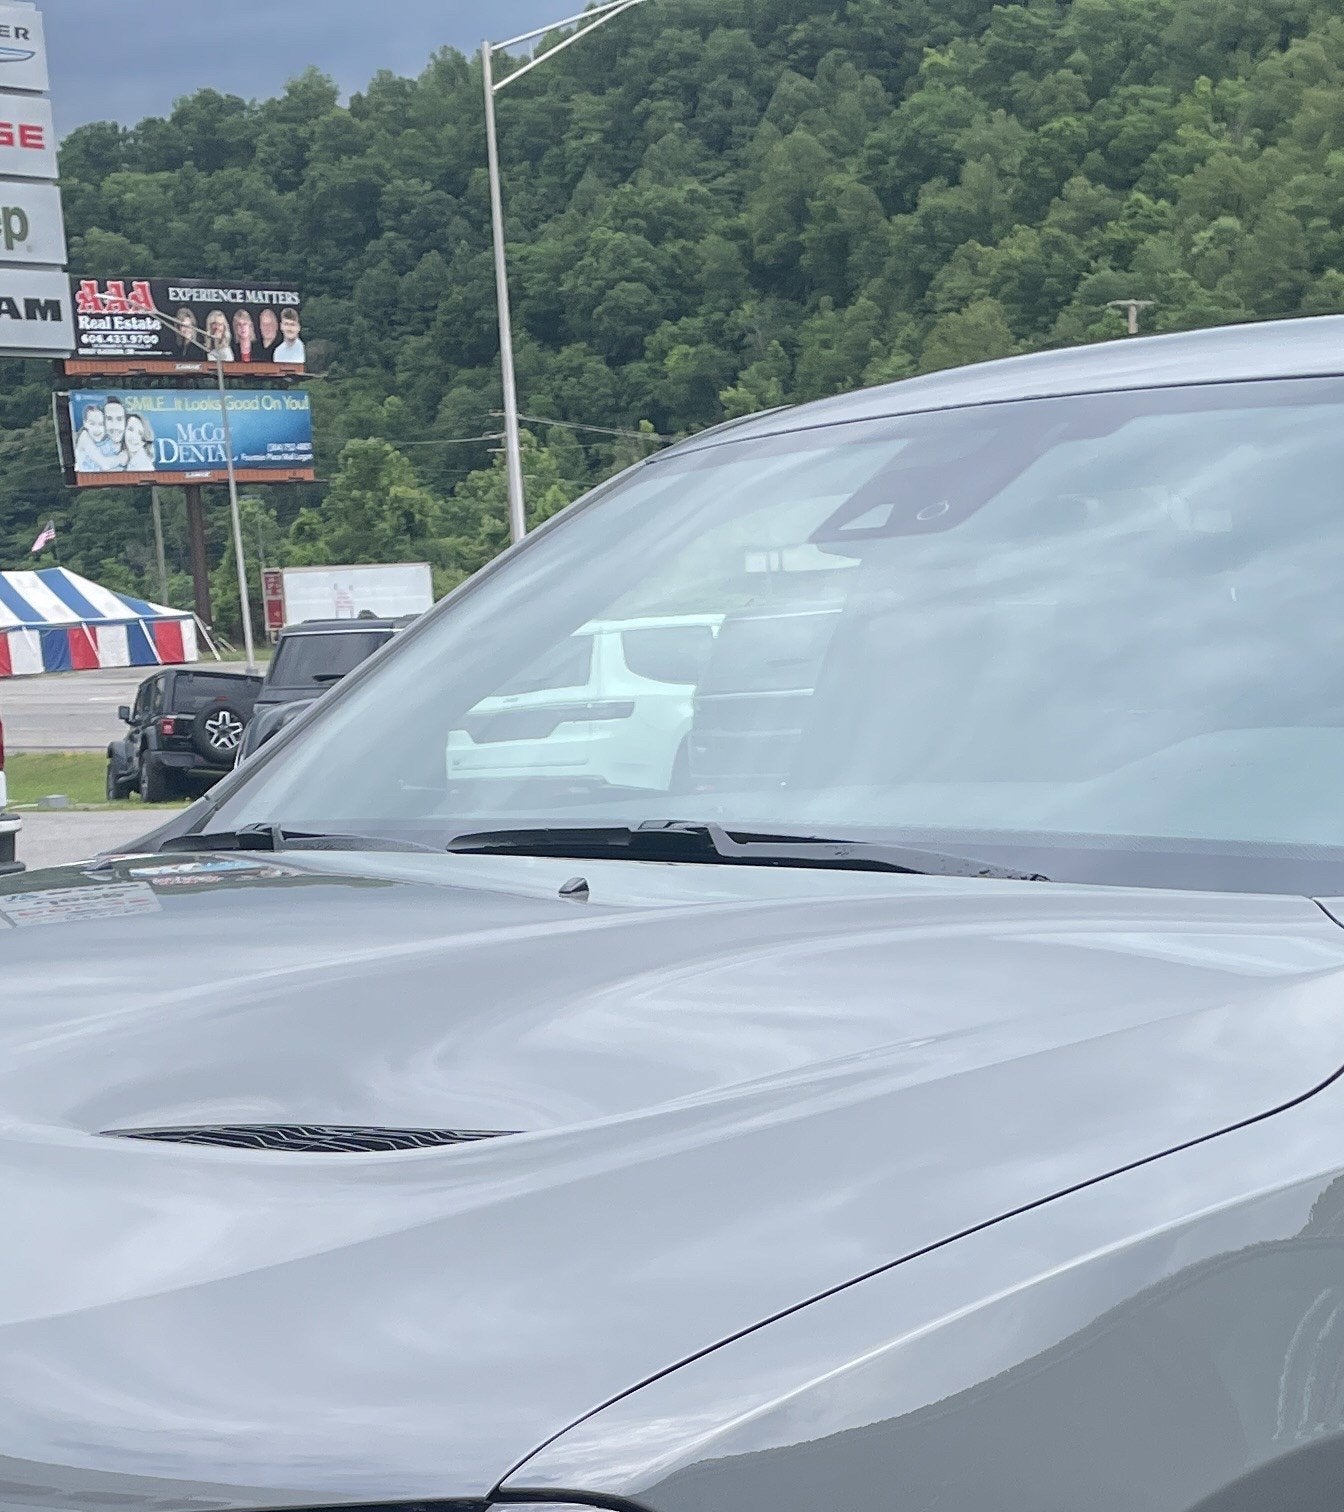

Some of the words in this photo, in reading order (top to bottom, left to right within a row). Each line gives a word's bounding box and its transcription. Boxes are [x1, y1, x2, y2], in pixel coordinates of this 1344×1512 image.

[168, 286, 244, 304] EXPERIENCE
[245, 289, 301, 305] MATTERS
[77, 315, 112, 330] Real
[113, 315, 162, 331] Estate
[224, 395, 259, 411] Good
[261, 395, 281, 411] On
[157, 437, 238, 464] DENTA
